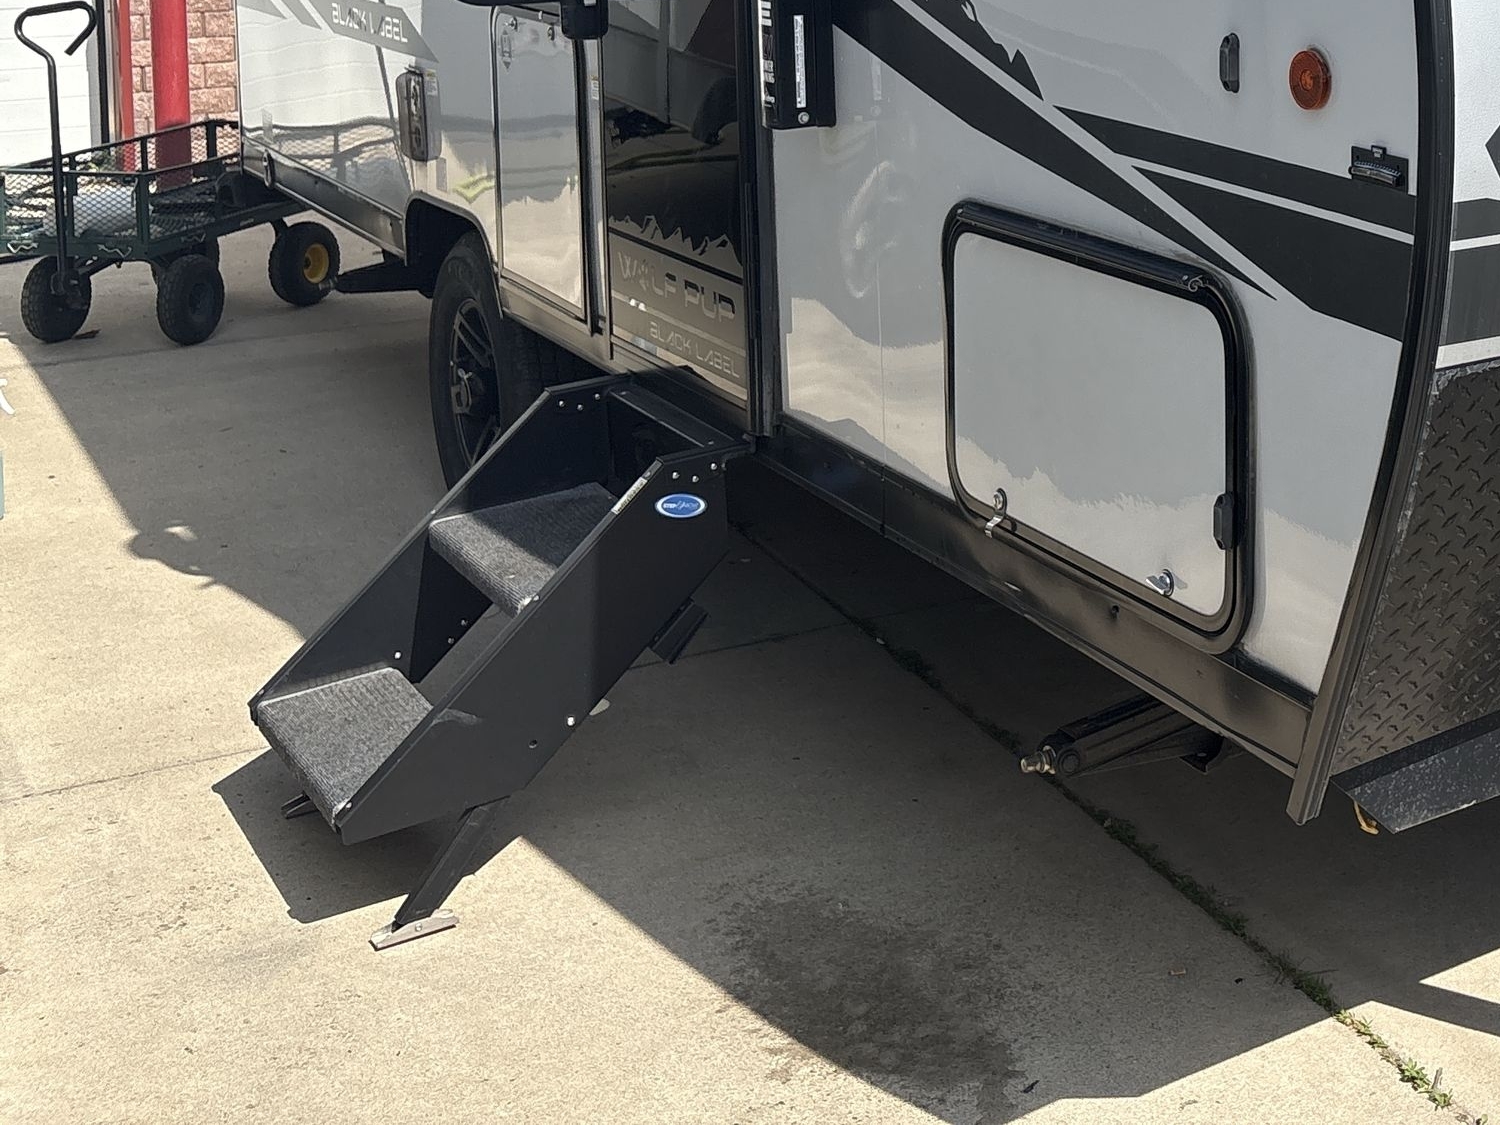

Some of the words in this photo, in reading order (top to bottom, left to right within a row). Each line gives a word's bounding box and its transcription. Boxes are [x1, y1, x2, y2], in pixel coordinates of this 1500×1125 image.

[331, 2, 368, 31] BLACK
[369, 11, 408, 43] LABEL
[684, 279, 737, 323] PUP
[650, 321, 692, 354] BLACK
[695, 342, 740, 378] LABEL
